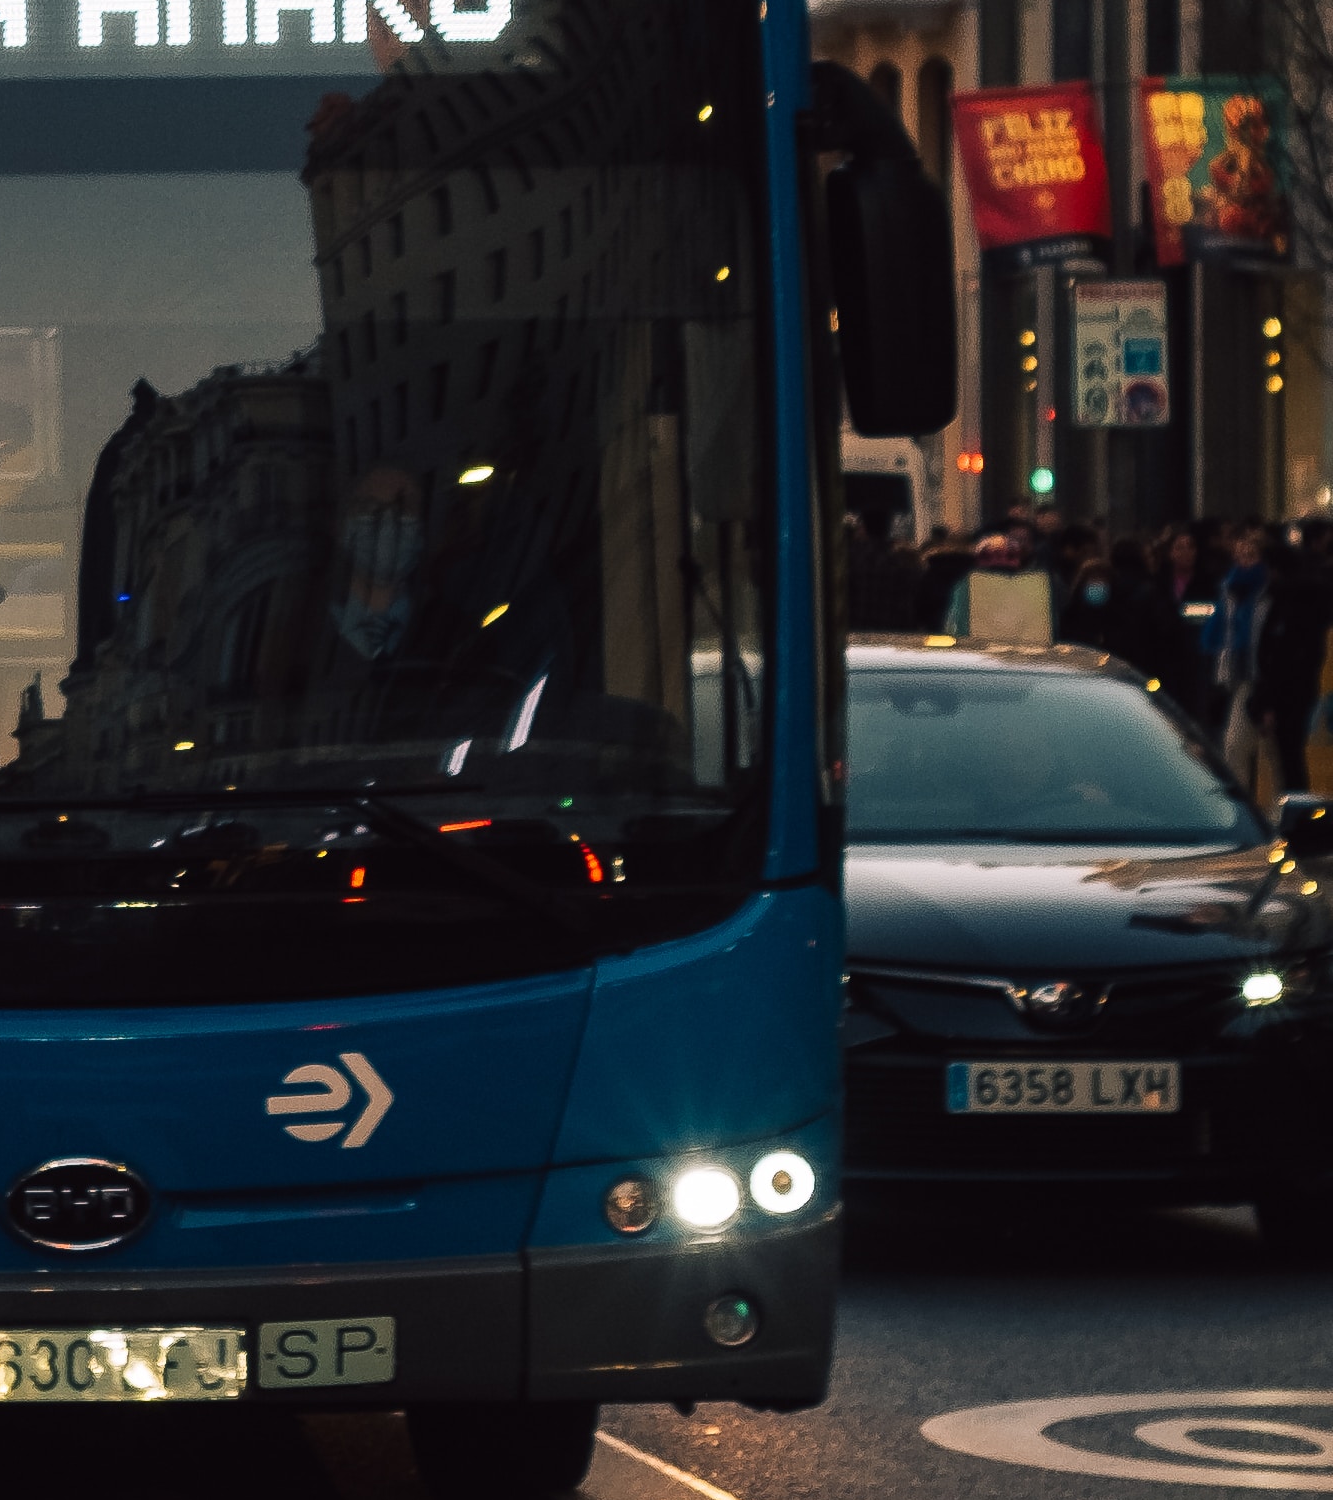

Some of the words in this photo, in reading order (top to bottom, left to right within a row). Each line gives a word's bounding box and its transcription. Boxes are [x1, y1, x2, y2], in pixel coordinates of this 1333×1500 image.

[974, 1069, 1075, 1106] 6358
[1091, 1068, 1170, 1106] LXH
[276, 1324, 377, 1380] SP
